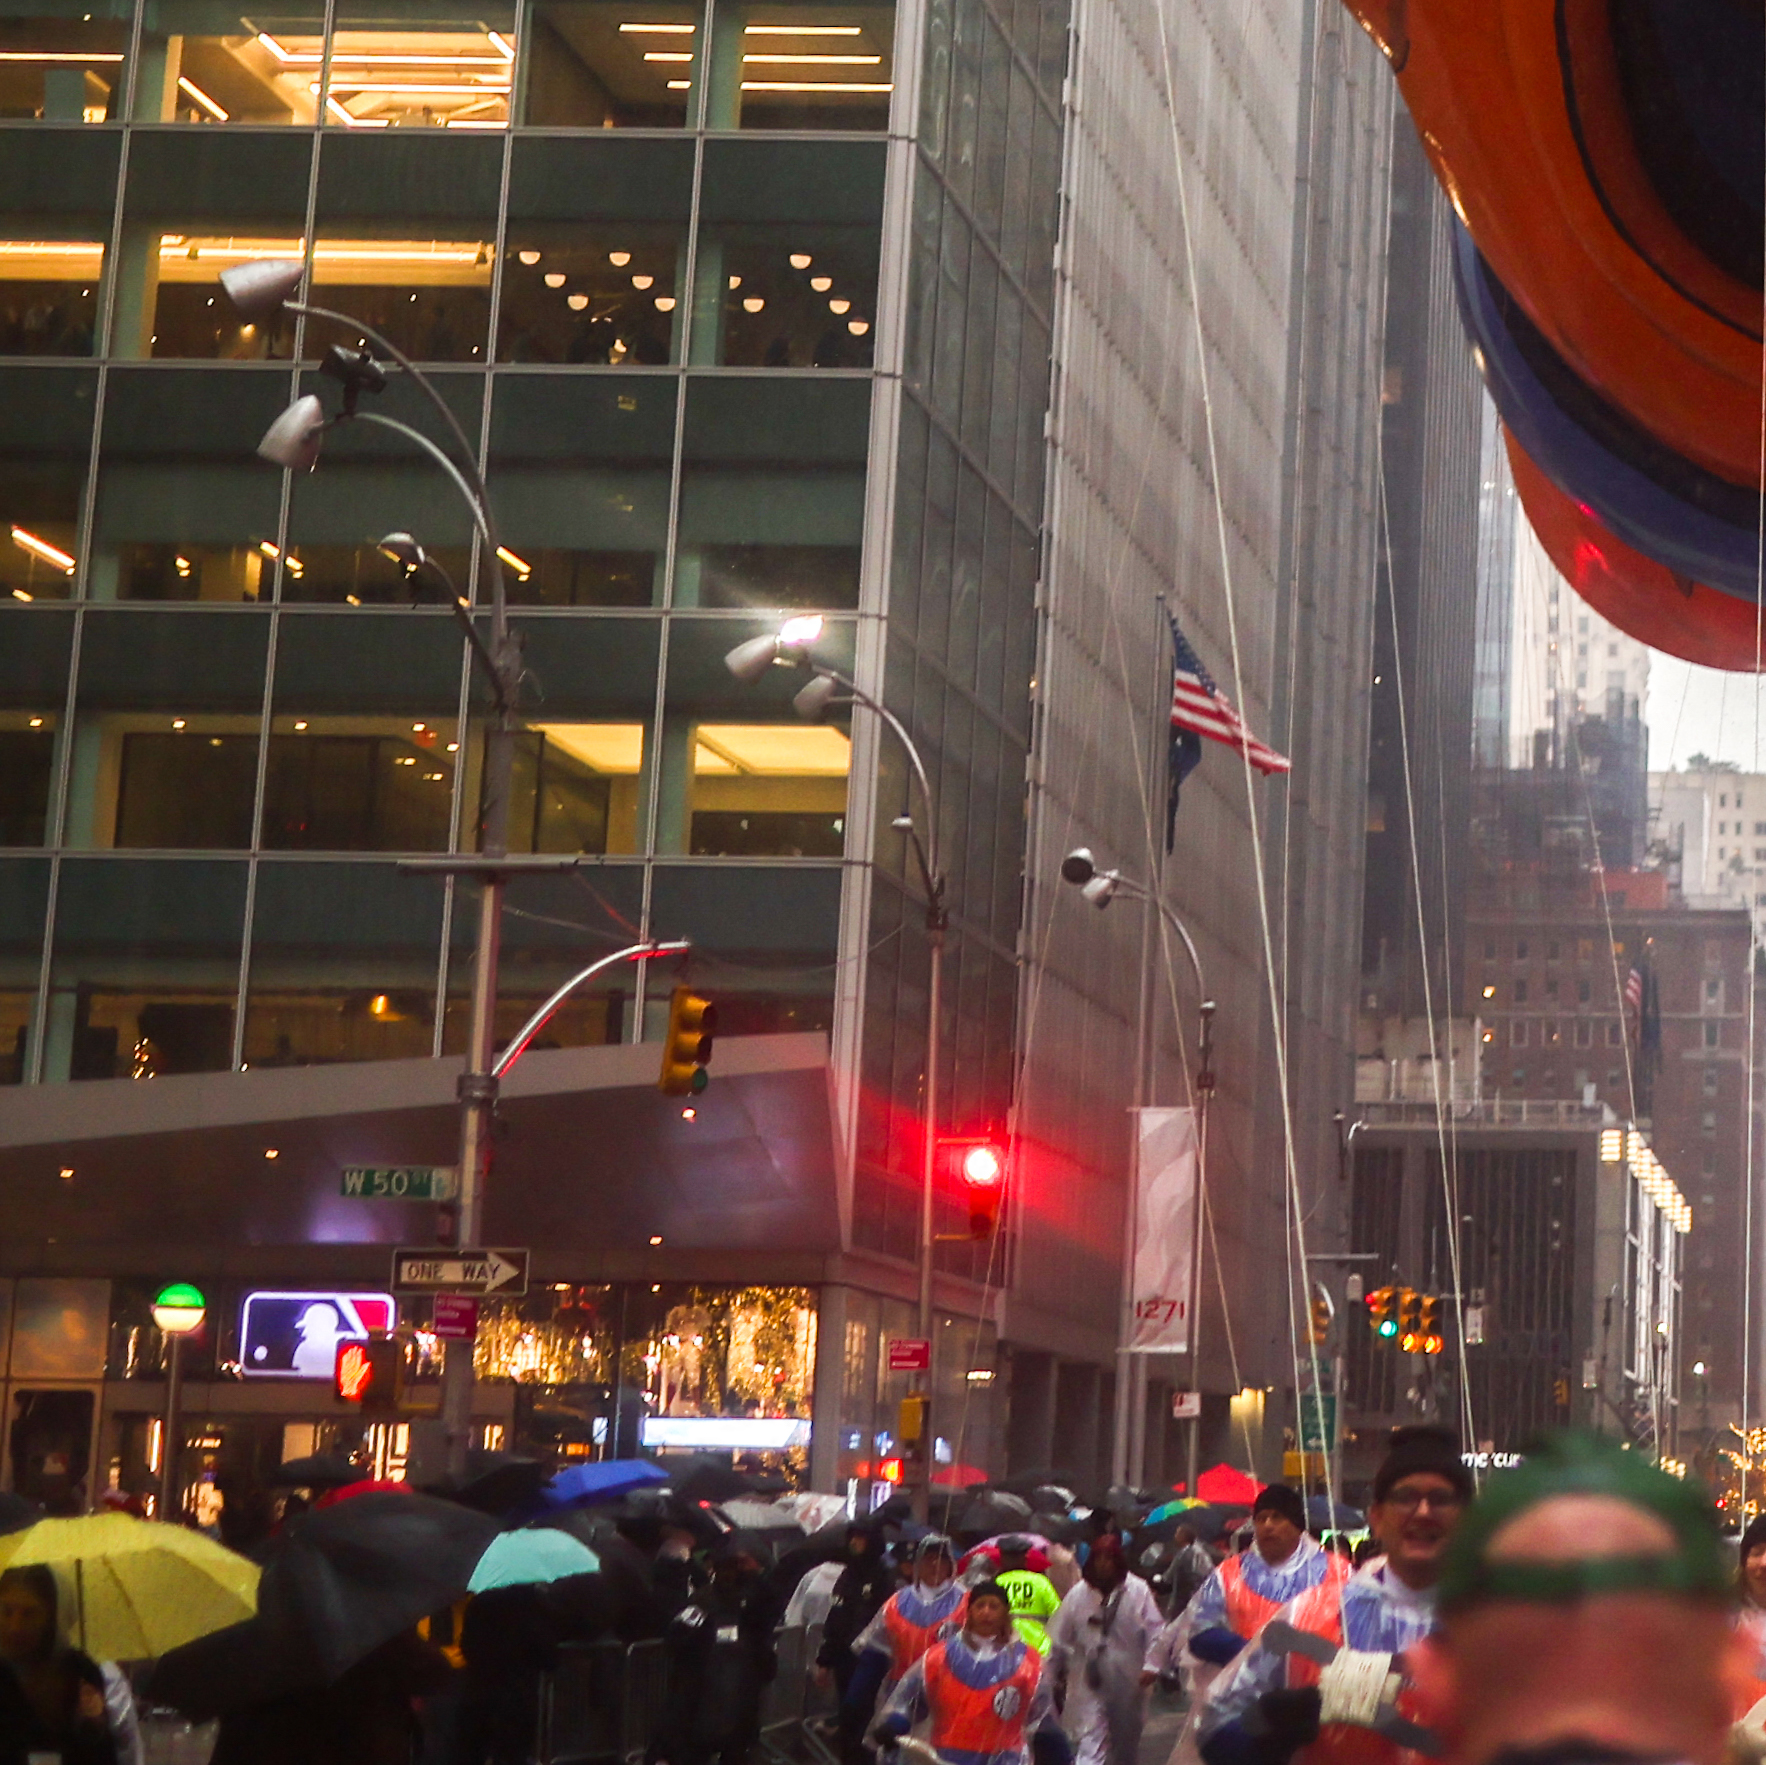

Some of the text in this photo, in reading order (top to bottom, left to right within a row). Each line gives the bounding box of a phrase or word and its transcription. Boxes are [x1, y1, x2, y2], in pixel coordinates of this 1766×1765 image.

[344, 1169, 366, 1195] W
[372, 1169, 409, 1196] 50
[407, 1262, 501, 1281] ONE WAY
[1134, 1297, 1187, 1323] 1271
